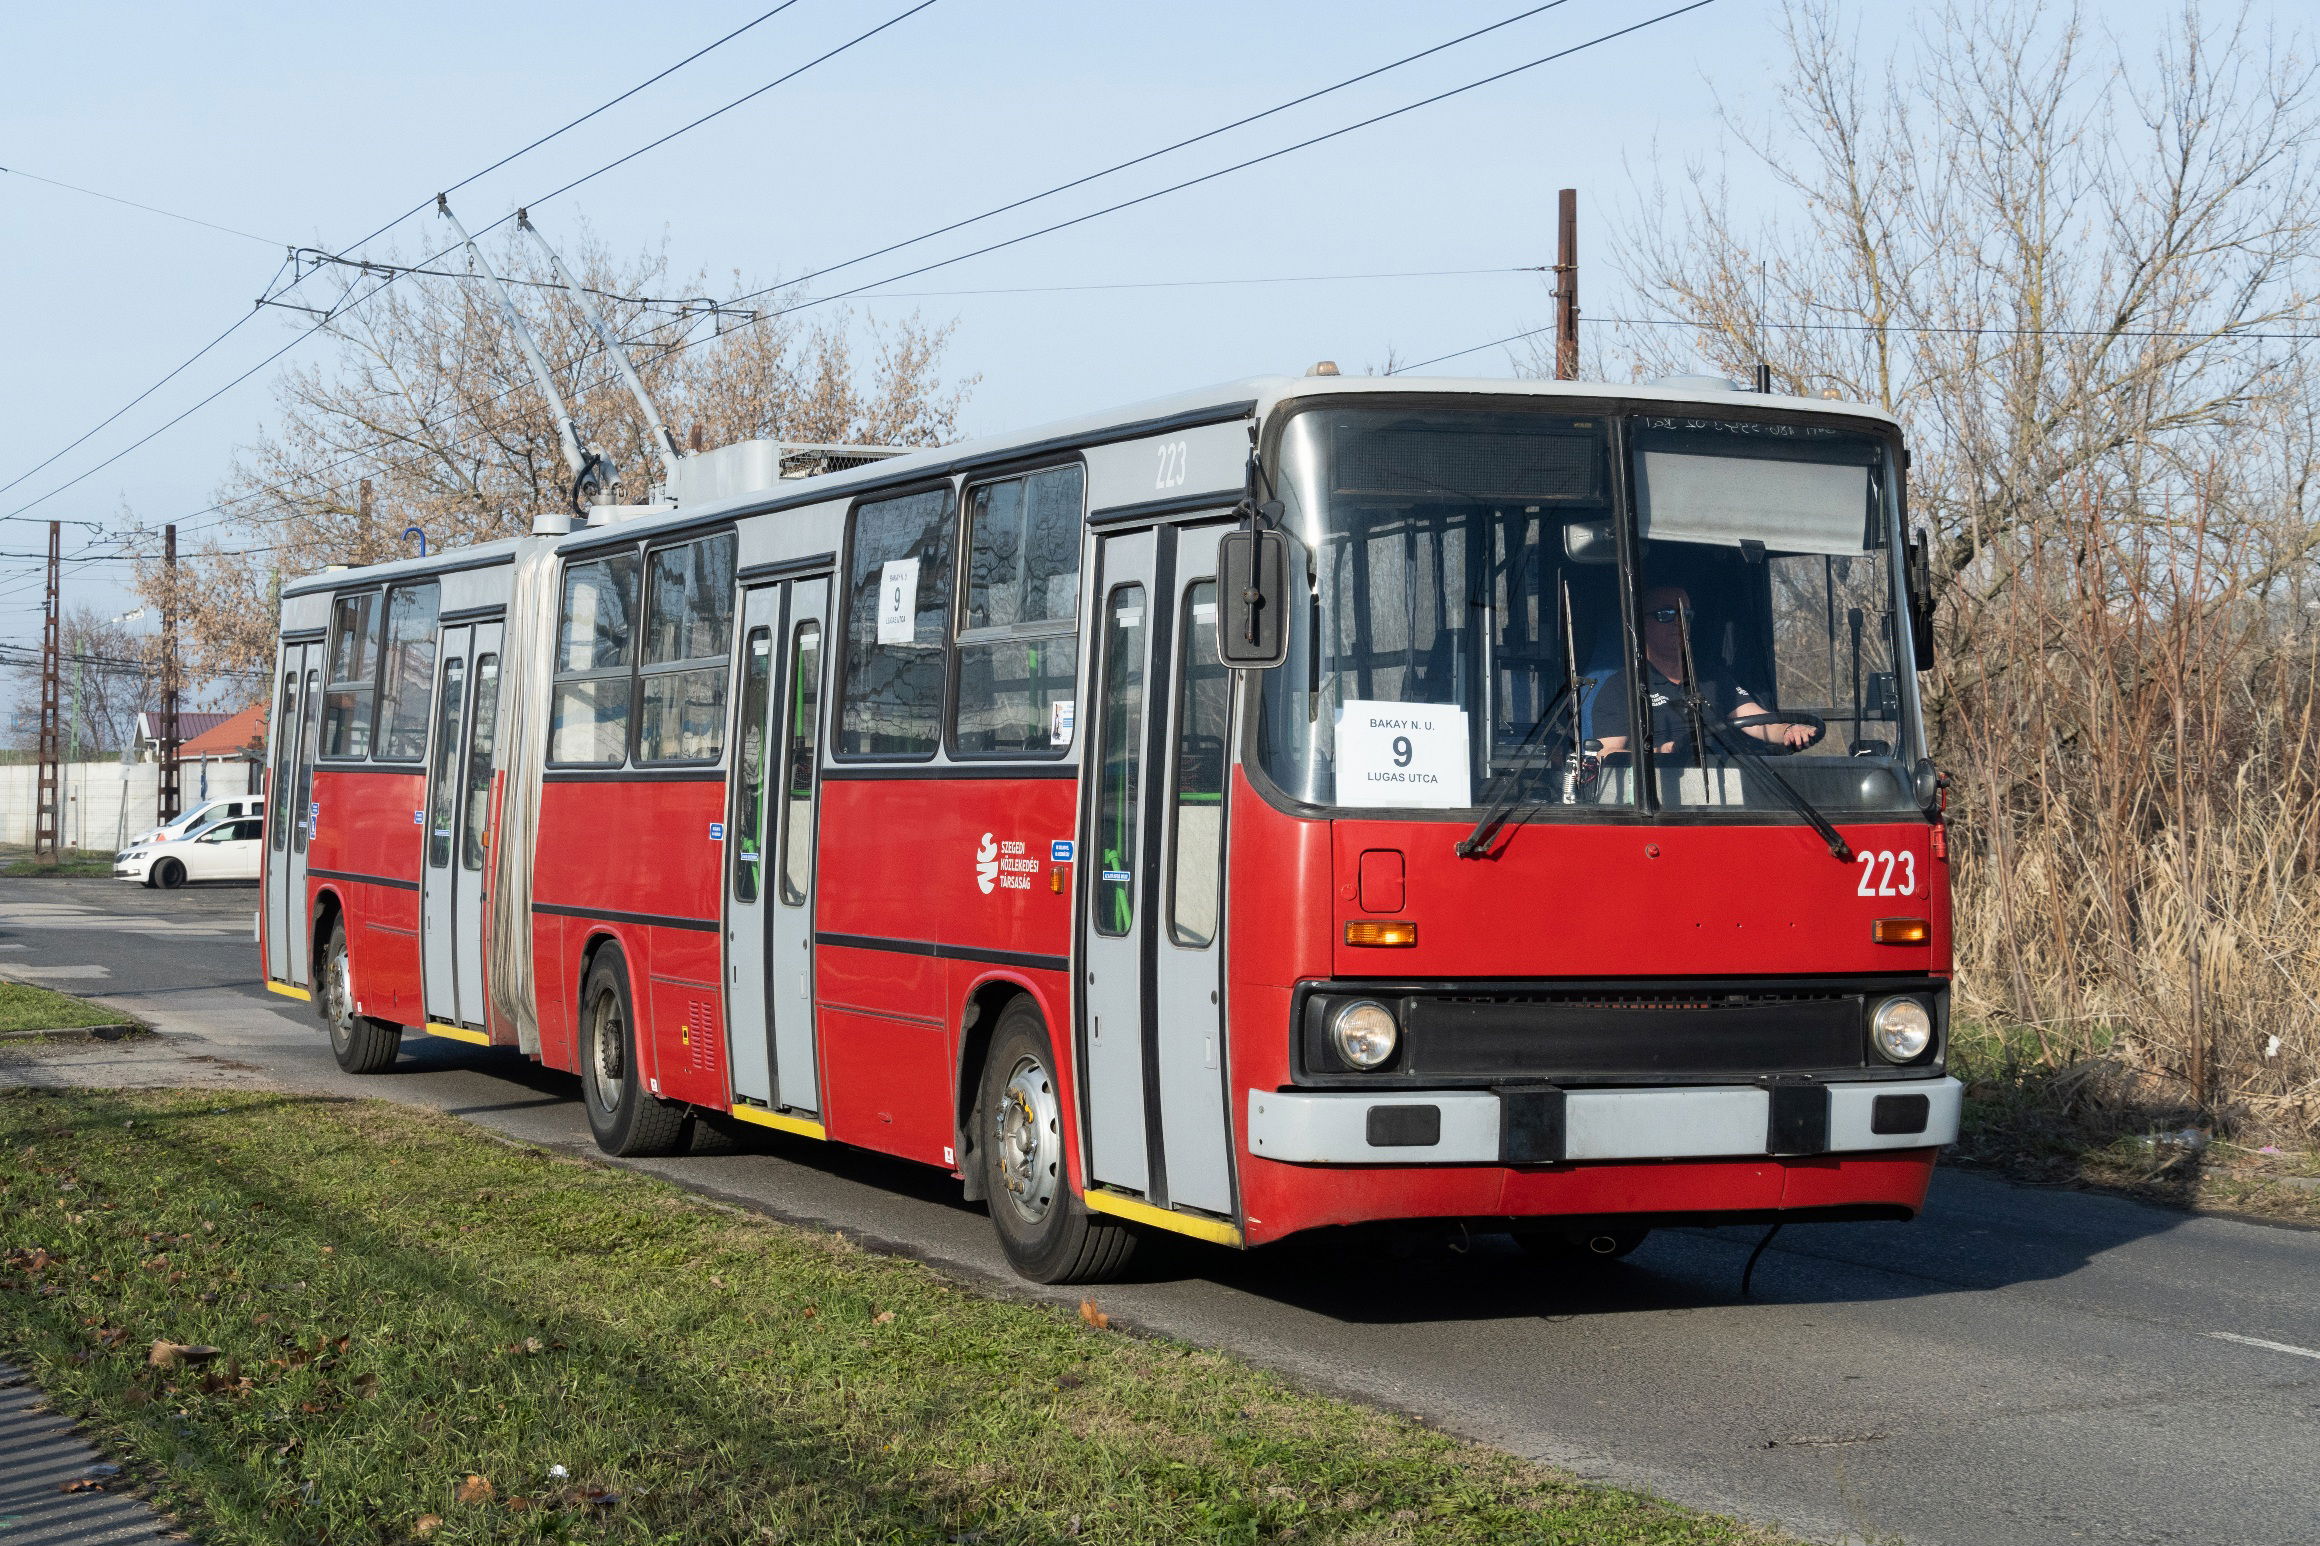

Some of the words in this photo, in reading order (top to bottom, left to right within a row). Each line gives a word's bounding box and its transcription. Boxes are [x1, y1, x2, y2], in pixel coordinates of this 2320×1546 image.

[1155, 441, 1187, 490] 223
[894, 587, 901, 612] 9
[1370, 719, 1408, 729] BAKAY
[1411, 721, 1422, 730] N.
[1424, 721, 1435, 731] U.
[1392, 735, 1413, 768] 9
[1367, 772, 1405, 782] LUGAS
[1408, 773, 1438, 784] UTCA
[1001, 840, 1026, 855] SZEGEDI
[1000, 855, 1039, 873] KÖZLEKEDÉSI
[1857, 850, 1915, 896] 223
[999, 872, 1031, 890] TÁRSASÁG
